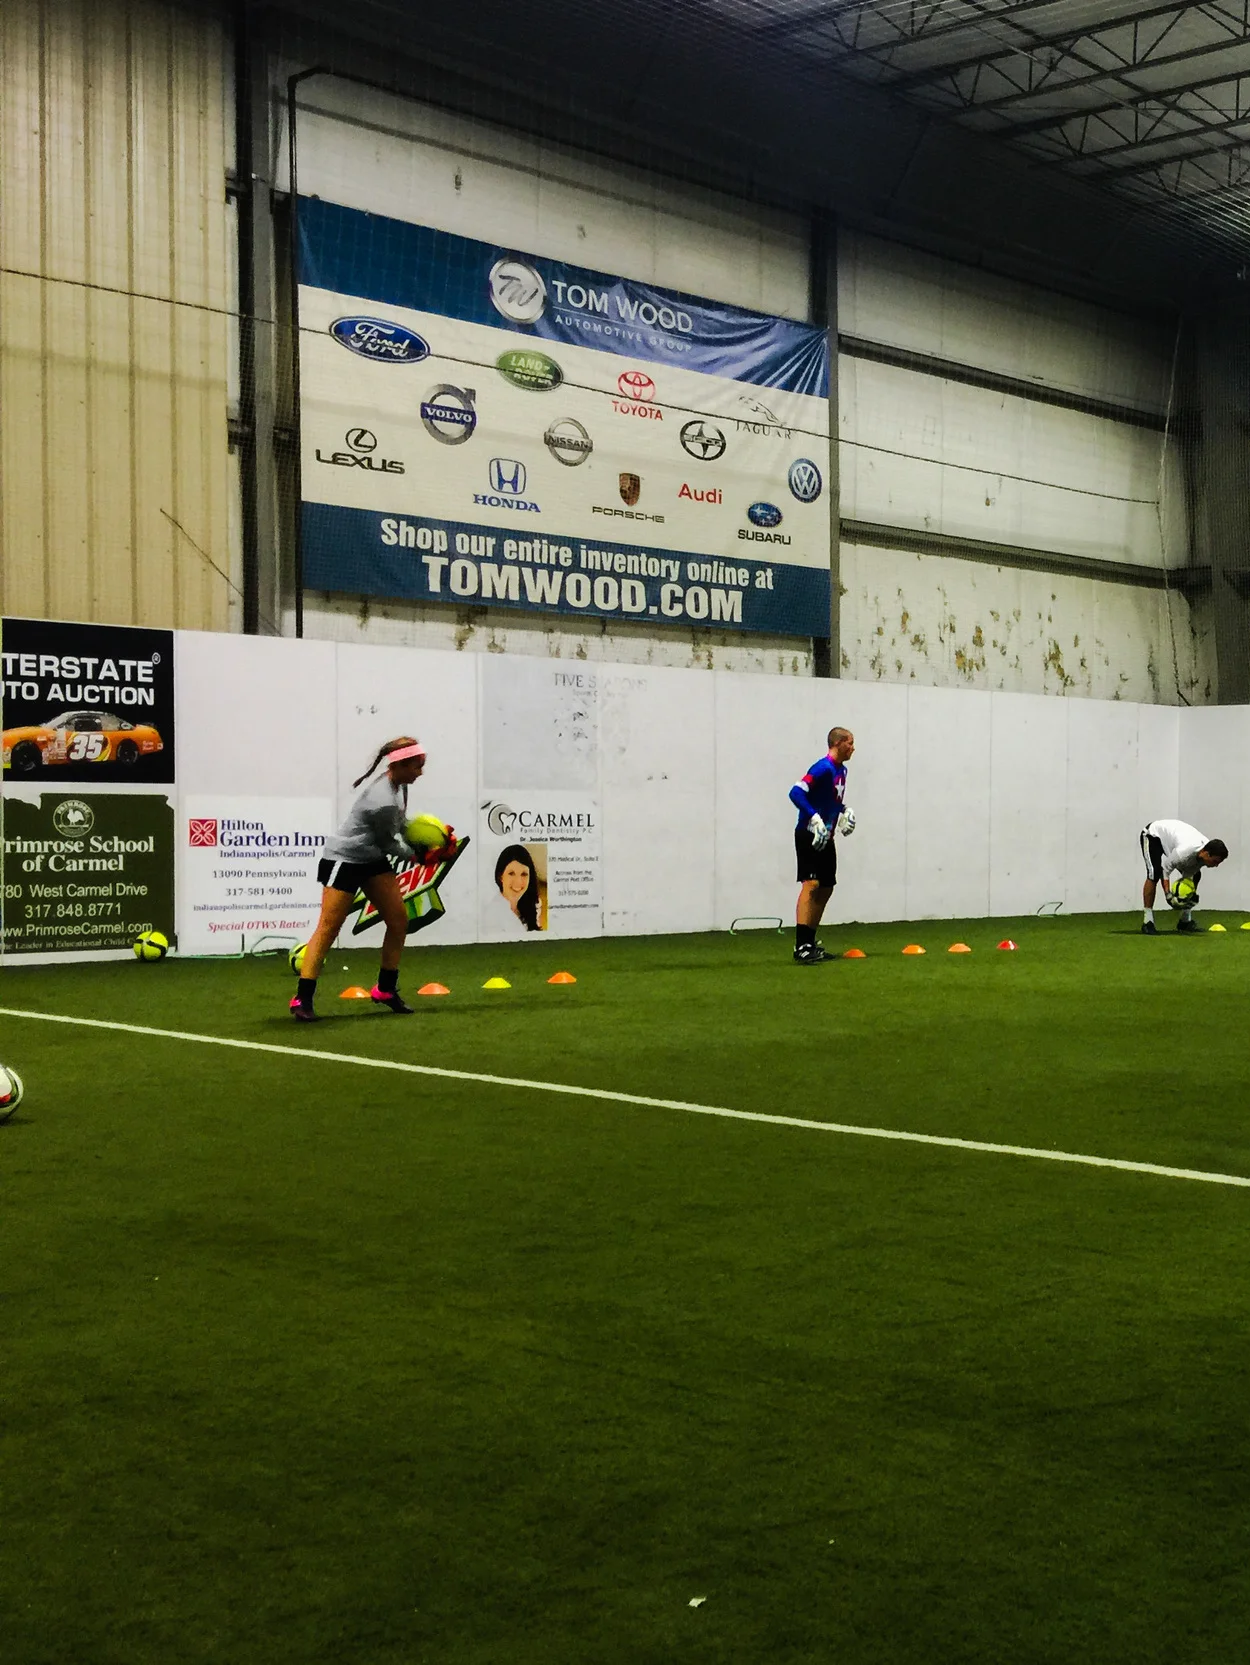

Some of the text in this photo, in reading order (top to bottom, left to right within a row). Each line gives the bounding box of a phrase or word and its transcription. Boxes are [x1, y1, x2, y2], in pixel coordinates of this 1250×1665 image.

[552, 280, 693, 334] TOM WOOD
[350, 322, 410, 357] Ford
[555, 315, 692, 353] AUTOMOTIVE GROUP
[424, 407, 472, 423] VOLVO
[612, 400, 663, 421] TOYOTA
[550, 434, 589, 449] NISSAN
[315, 449, 405, 475] LEXUS
[678, 483, 722, 504] Audi
[473, 493, 541, 513] HONDA
[592, 506, 665, 524] PORSCHE
[737, 529, 791, 545] SUBARU
[380, 518, 774, 590] Shop our entire inventory online at
[421, 555, 743, 623] TOMWOOD.COM
[47, 683, 155, 706] AUCTION
[70, 734, 104, 760] 35
[221, 819, 264, 831] Hilton
[518, 811, 595, 827] CARMEL
[0, 836, 154, 853] rimrose School
[220, 831, 325, 847] Garden Inn
[22, 854, 124, 872] of Carmel
[220, 849, 315, 860] Indianapolis/Carmel
[213, 869, 307, 880] 13090 Pennsylvania
[29, 884, 63, 898] West
[66, 883, 112, 897] Carmel
[115, 882, 148, 896] Drive
[24, 902, 121, 918] 317.848.8771
[208, 921, 245, 933] Special
[279, 919, 310, 930] Rates!
